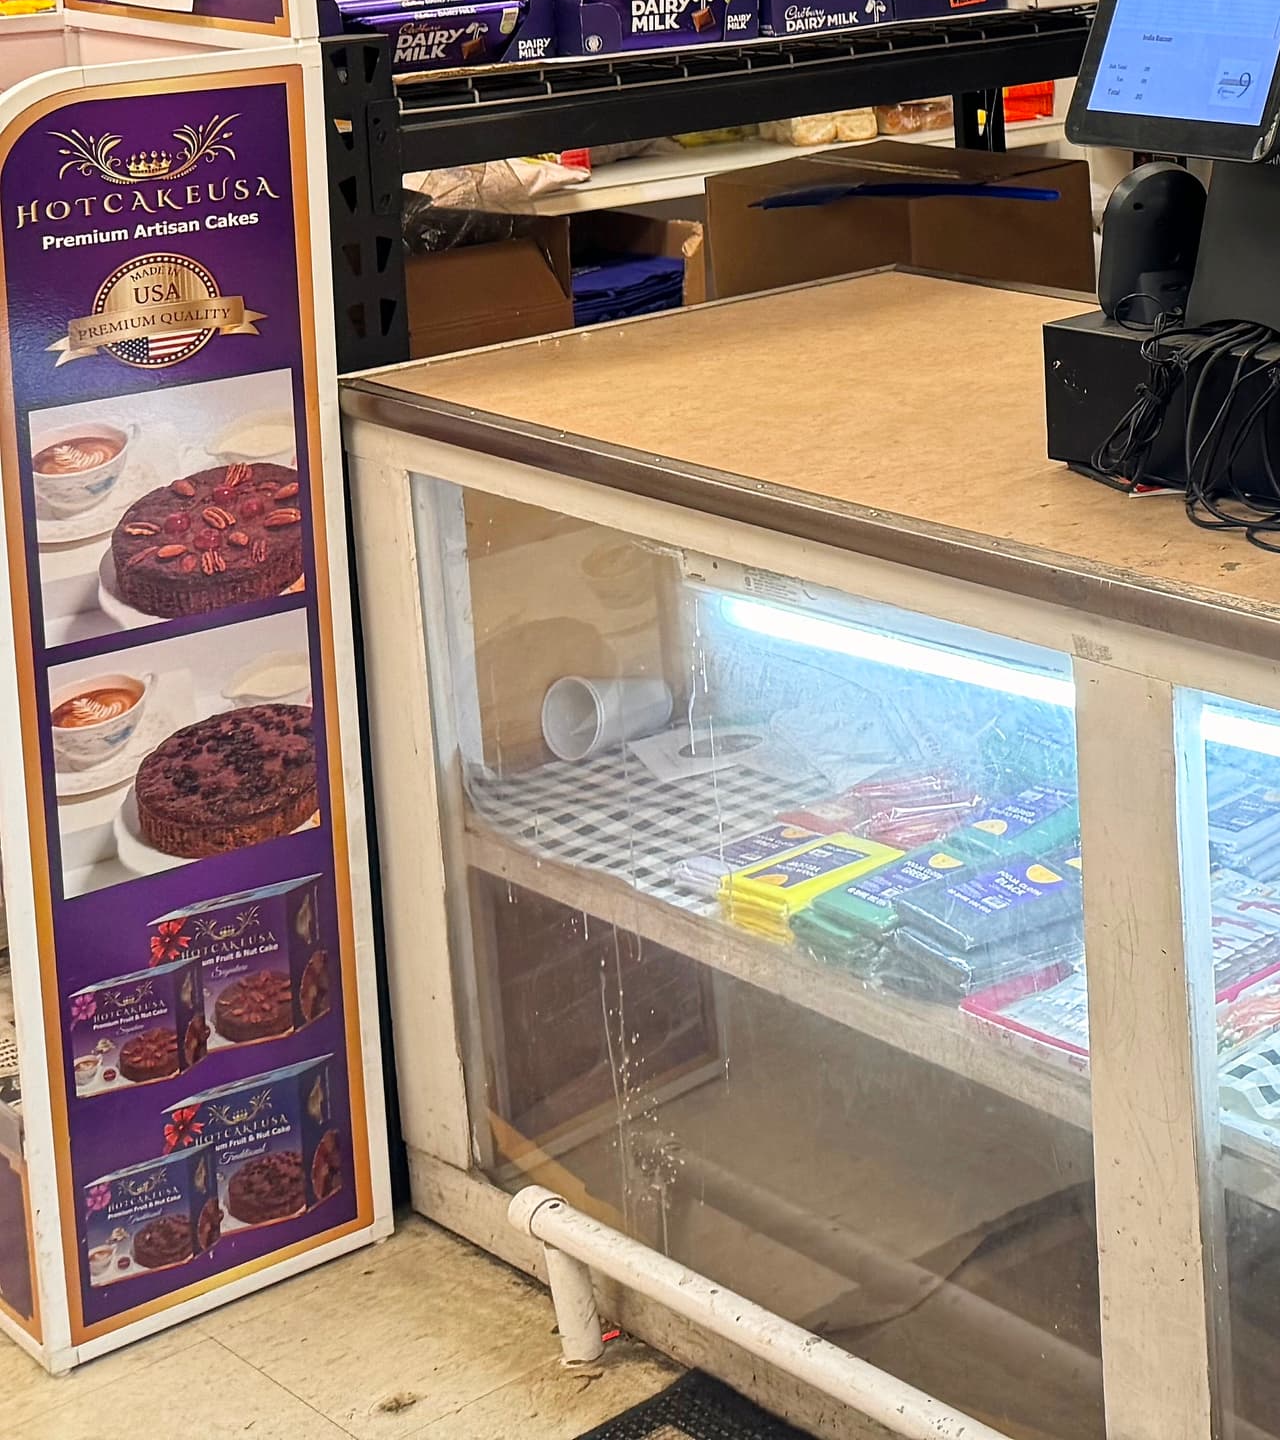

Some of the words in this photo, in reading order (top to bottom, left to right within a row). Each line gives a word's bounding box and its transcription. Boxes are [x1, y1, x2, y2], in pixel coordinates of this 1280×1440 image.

[726, 12, 752, 28] DAIRY
[784, 5, 825, 20] Cadbury
[786, 17, 827, 32] DAIRY
[827, 11, 859, 27] MILK
[631, 12, 680, 34] MILK
[726, 18, 749, 31] MILK
[398, 27, 465, 49] DAIRY
[518, 38, 551, 50] DAIRY
[393, 44, 447, 64] MILK
[518, 47, 545, 59] MILK
[16, 176, 280, 229] HOTCAKEUSA
[42, 227, 129, 250] Premium
[133, 218, 200, 239] Artisan
[205, 211, 259, 229] Cakes
[130, 265, 165, 283] MADE
[166, 266, 181, 277] IN
[133, 282, 181, 304] USA
[78, 314, 156, 342] PREMIUM
[160, 307, 231, 326] QUALITY
[244, 948, 258, 956] Nut
[260, 944, 278, 952] Cake
[229, 1138, 247, 1148] Fruit
[272, 1125, 291, 1135] Cake
